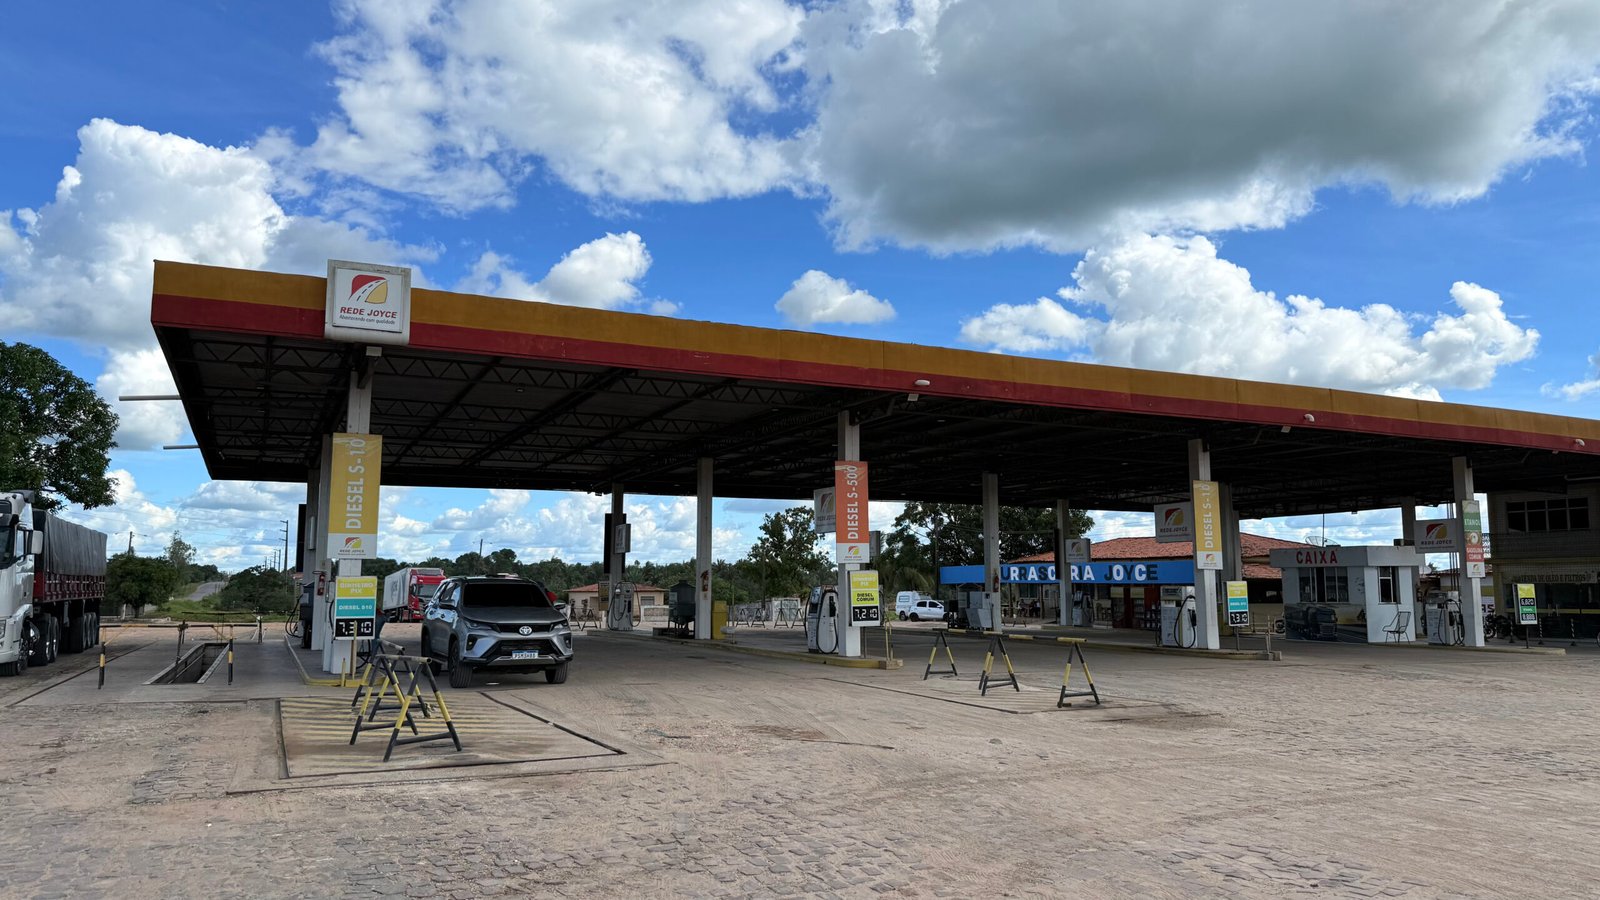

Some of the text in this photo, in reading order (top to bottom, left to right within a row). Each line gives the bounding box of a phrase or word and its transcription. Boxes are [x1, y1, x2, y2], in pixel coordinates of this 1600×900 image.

[340, 306, 398, 319] REDE JOYCE
[345, 478, 364, 529] DIESEL
[847, 465, 859, 540] DIESEL S-500
[1203, 512, 1214, 549] DIESEL
[1296, 550, 1338, 565] CAIXA
[1000, 563, 1158, 581] URRASCRIA JOYCE
